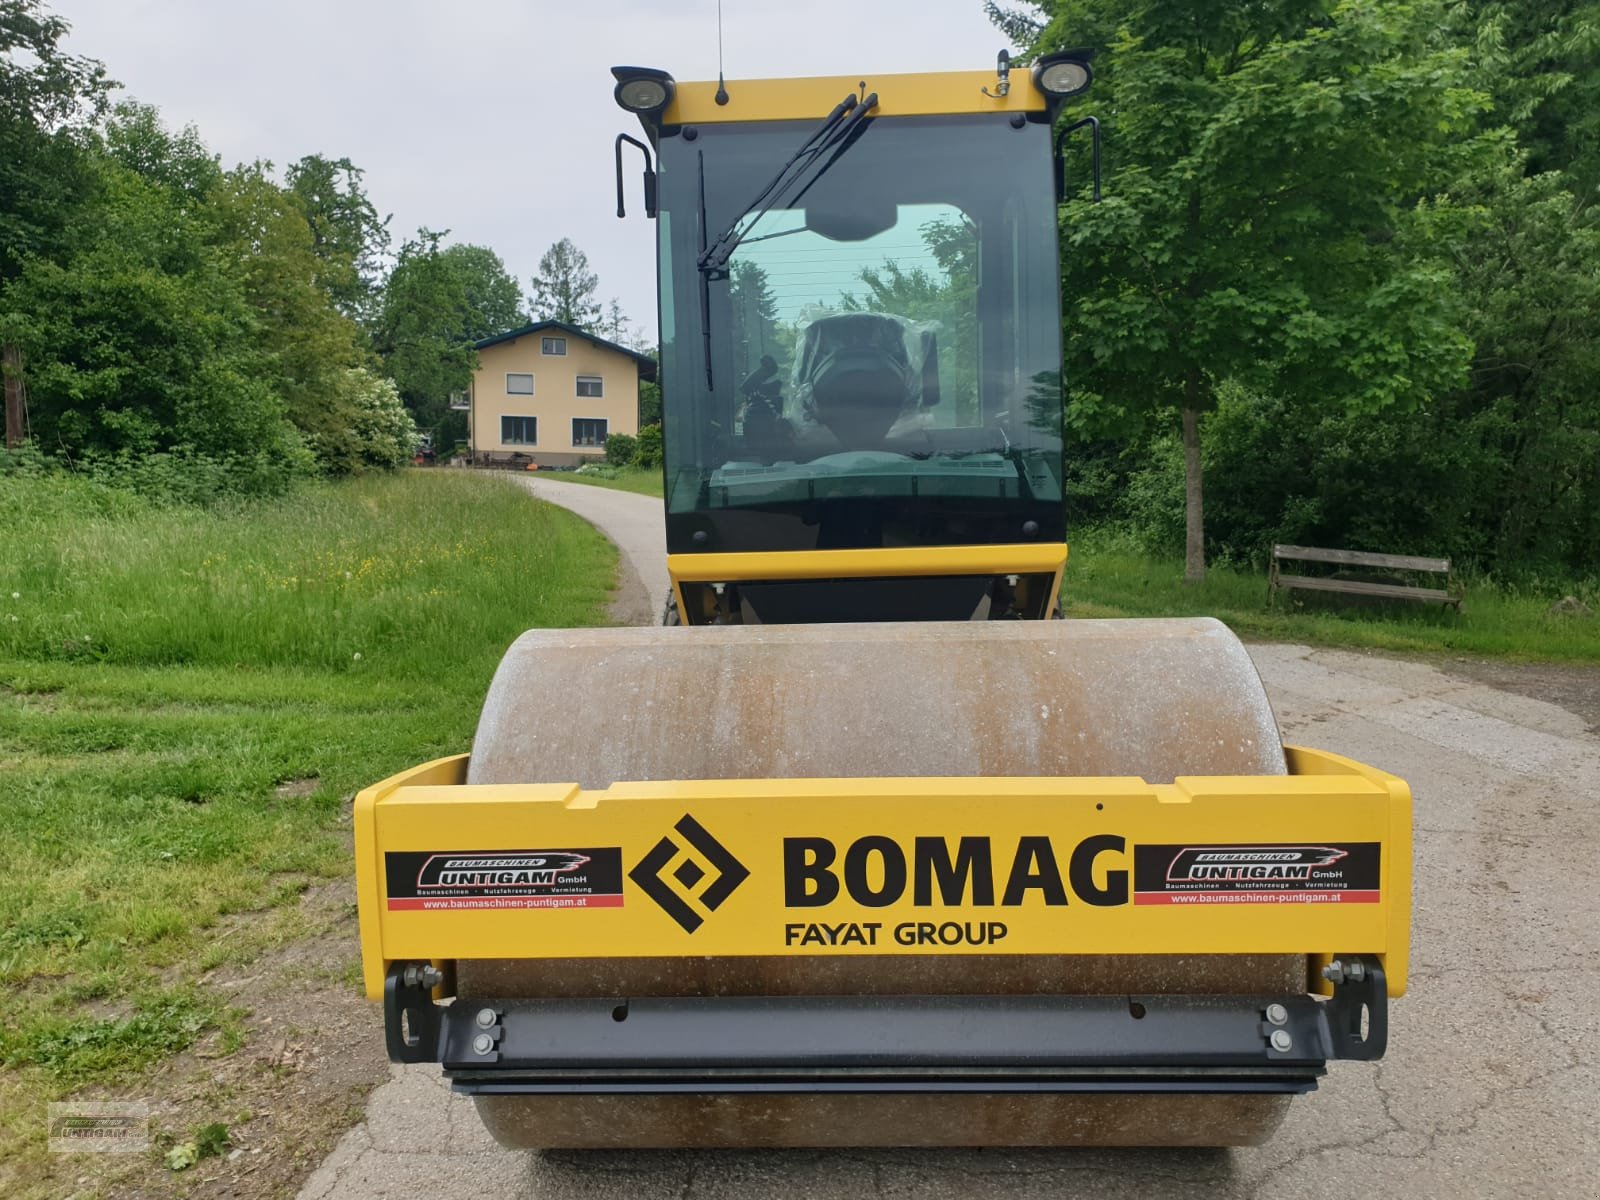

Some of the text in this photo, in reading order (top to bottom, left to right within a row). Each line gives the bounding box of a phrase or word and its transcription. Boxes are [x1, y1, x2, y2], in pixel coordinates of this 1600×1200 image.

[1201, 853, 1296, 861] BAUMASCHINEN
[449, 859, 541, 867] BAUMASCHINEN
[784, 834, 1129, 907] BOMAG
[1312, 870, 1343, 878] GmbH
[557, 876, 588, 884] GmbH
[1171, 891, 1341, 903] www.baumaschinen-puntigam.at
[423, 898, 588, 909] www.baumaschinen-puntigam.at
[785, 922, 1008, 946] FAYAT GROUP
